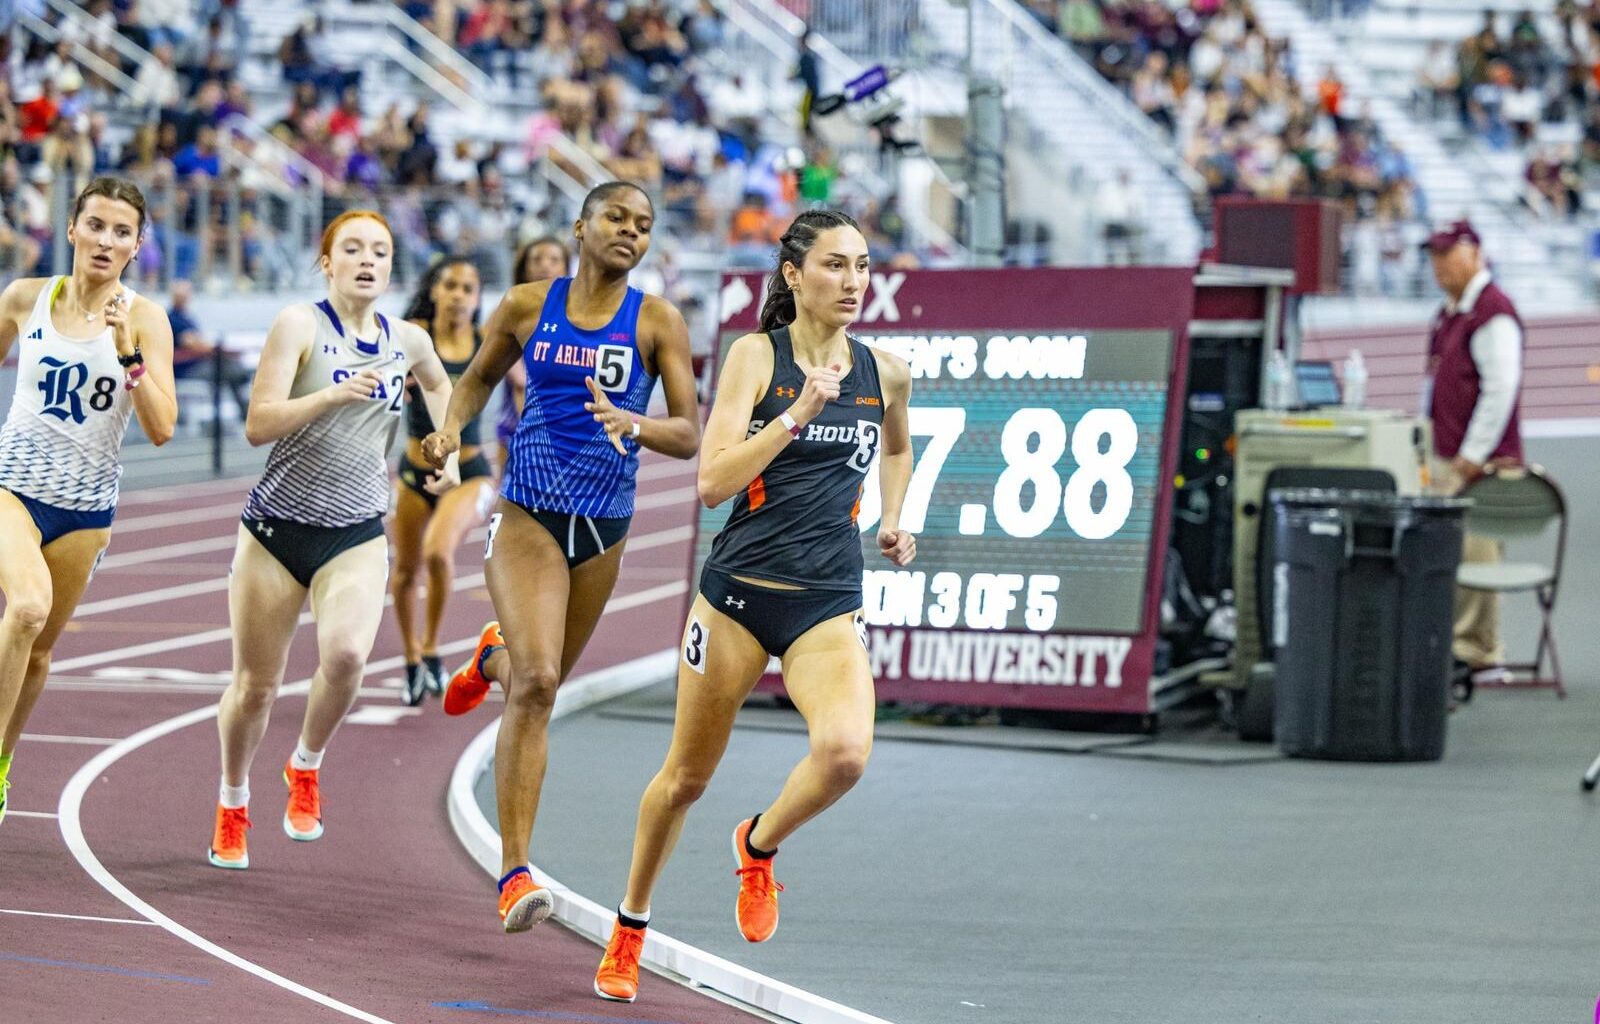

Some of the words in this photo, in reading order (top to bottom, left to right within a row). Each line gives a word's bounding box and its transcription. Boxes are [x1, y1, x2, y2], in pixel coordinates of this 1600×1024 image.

[533, 341, 551, 362] UT
[554, 344, 600, 368] ARLIN
[598, 348, 625, 388] 5
[983, 335, 1087, 380] 800M
[37, 356, 89, 425] R
[89, 376, 117, 412] 8
[389, 375, 405, 411] 2
[855, 424, 879, 469] 3
[857, 406, 1139, 540] 7.88
[928, 572, 962, 628] 3
[965, 573, 1024, 630] OF
[1025, 574, 1061, 631] 5
[686, 621, 702, 666] 3
[908, 631, 1132, 688] UNIVERSITY
